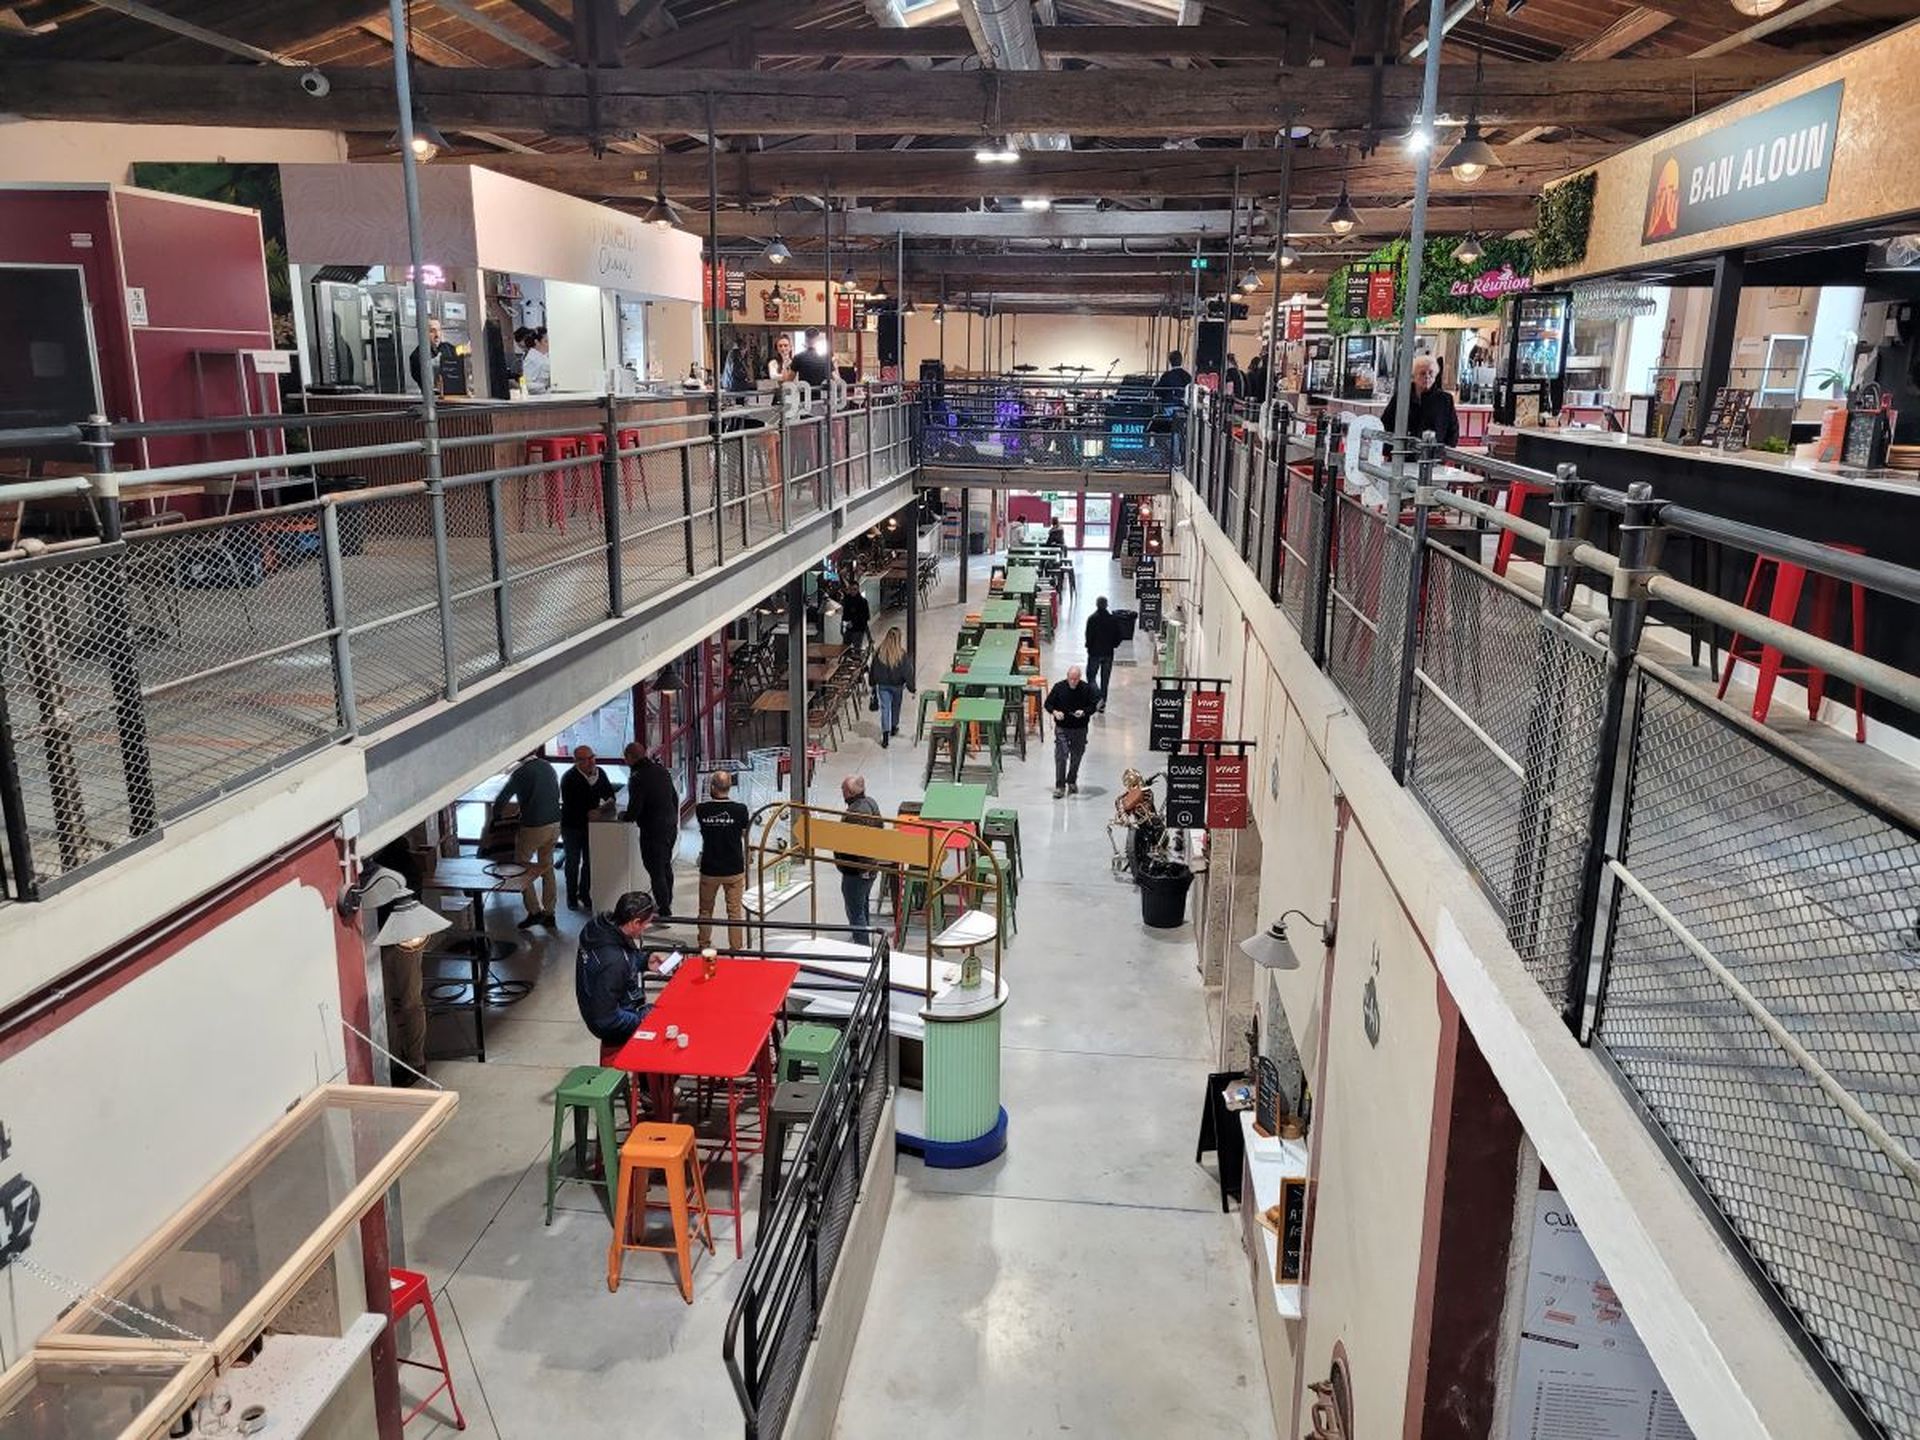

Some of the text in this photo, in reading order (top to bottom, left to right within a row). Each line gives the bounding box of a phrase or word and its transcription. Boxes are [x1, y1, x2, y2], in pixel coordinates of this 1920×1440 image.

[1688, 121, 1829, 206] BAN ALOUN
[1449, 277, 1530, 295] La Réunion
[1215, 765, 1241, 775] VINS
